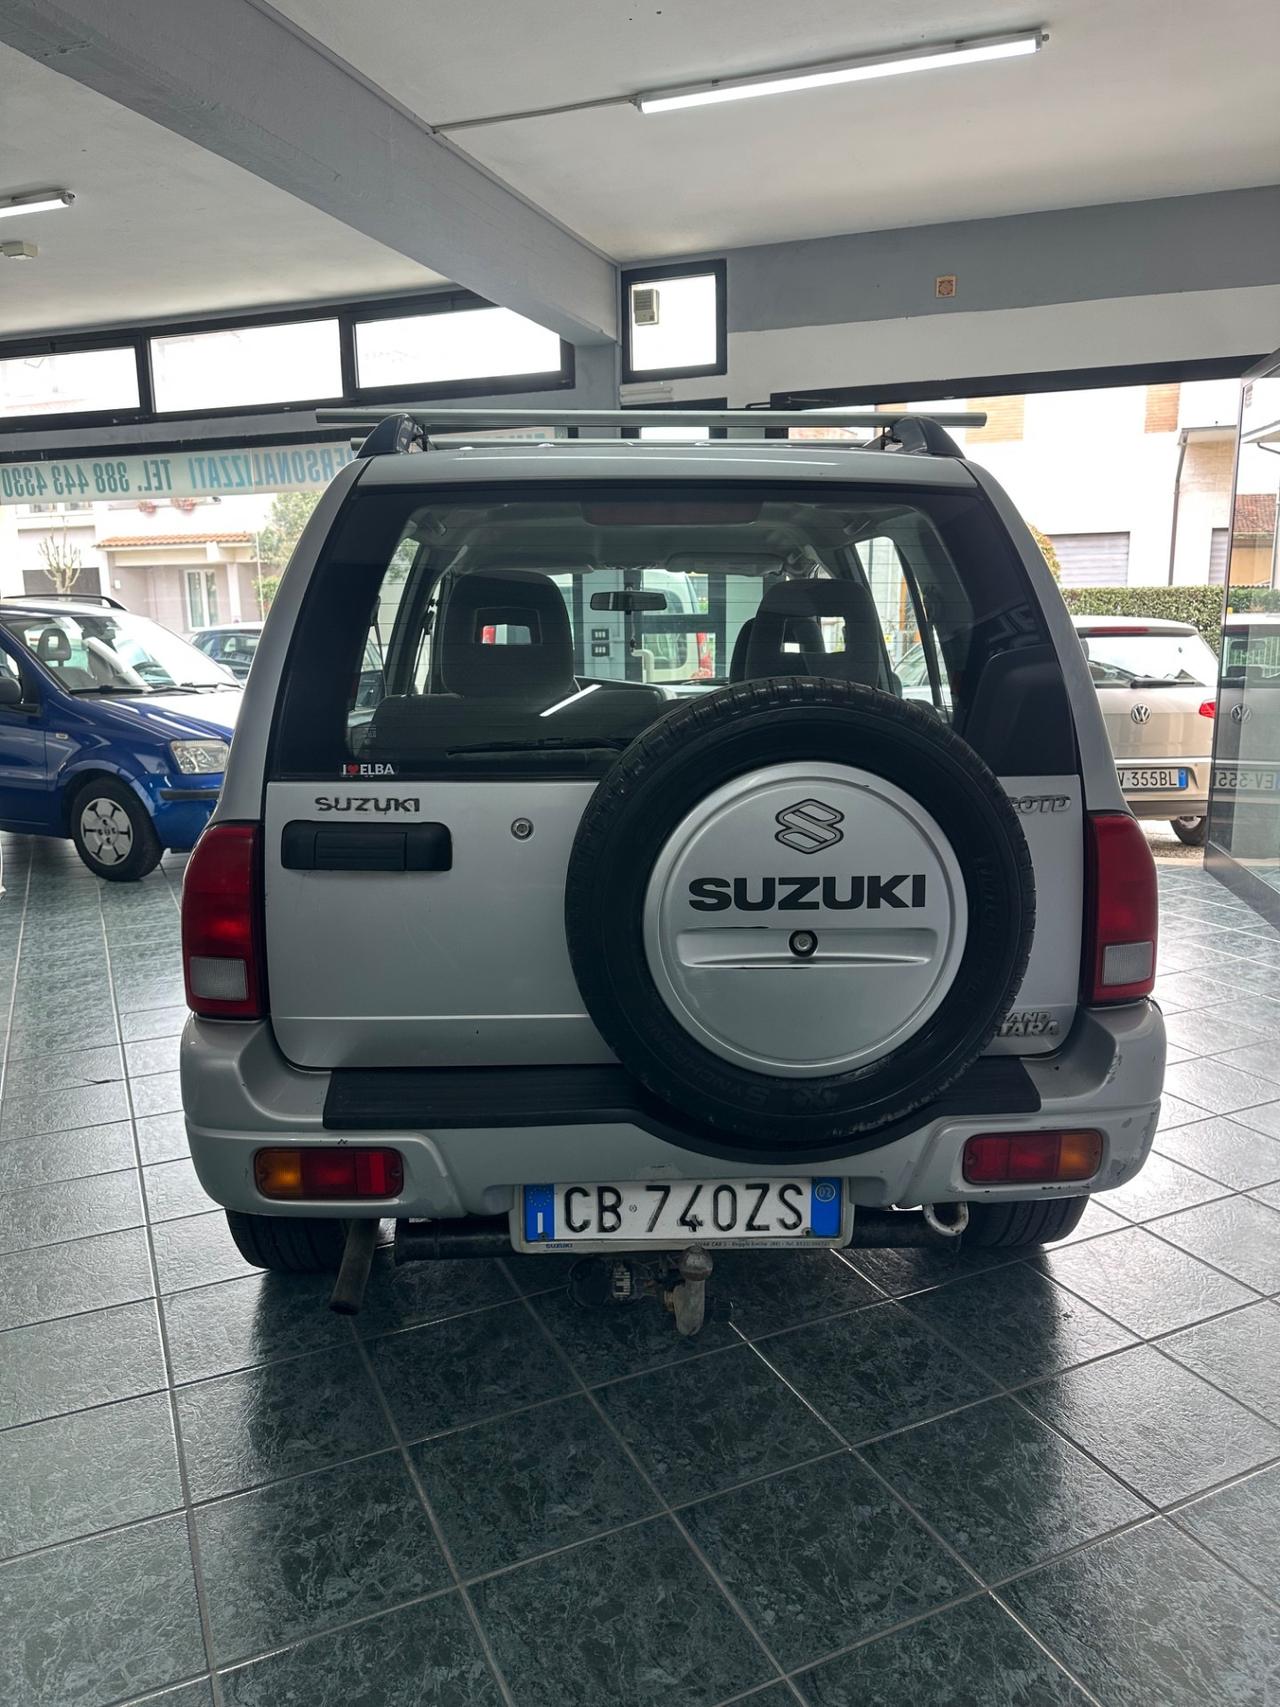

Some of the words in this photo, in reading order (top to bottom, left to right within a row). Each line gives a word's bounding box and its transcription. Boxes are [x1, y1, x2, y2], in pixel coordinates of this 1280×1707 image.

[360, 763, 395, 775] ELBA
[1131, 770, 1177, 787] 355BL
[314, 796, 420, 813] SUZUKI
[688, 874, 926, 912] SUZUKI
[999, 1020, 1060, 1037] TARA
[537, 1212, 544, 1234] I
[564, 1186, 624, 1233] CB
[645, 1183, 804, 1233] 740ZS
